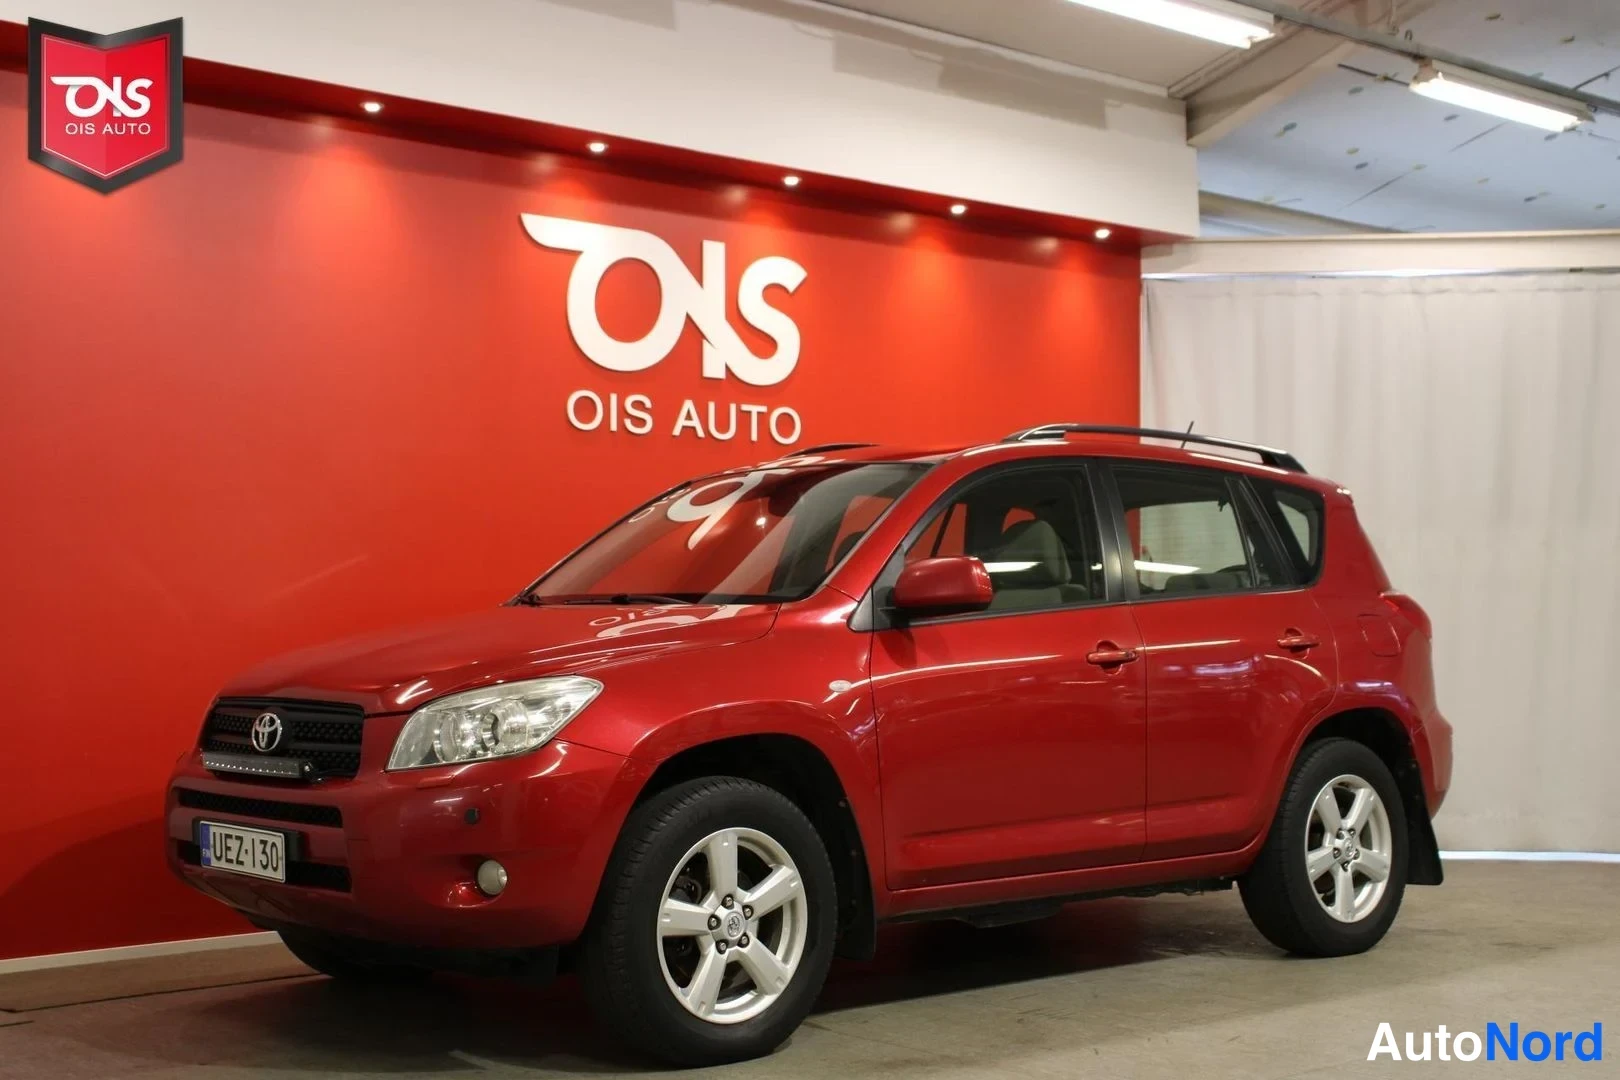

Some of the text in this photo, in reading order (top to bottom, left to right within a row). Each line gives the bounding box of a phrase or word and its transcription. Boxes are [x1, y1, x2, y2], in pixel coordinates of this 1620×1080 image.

[520, 212, 808, 386] OIS
[566, 389, 802, 445] OIS AUTO
[212, 831, 279, 872] UEZ-130
